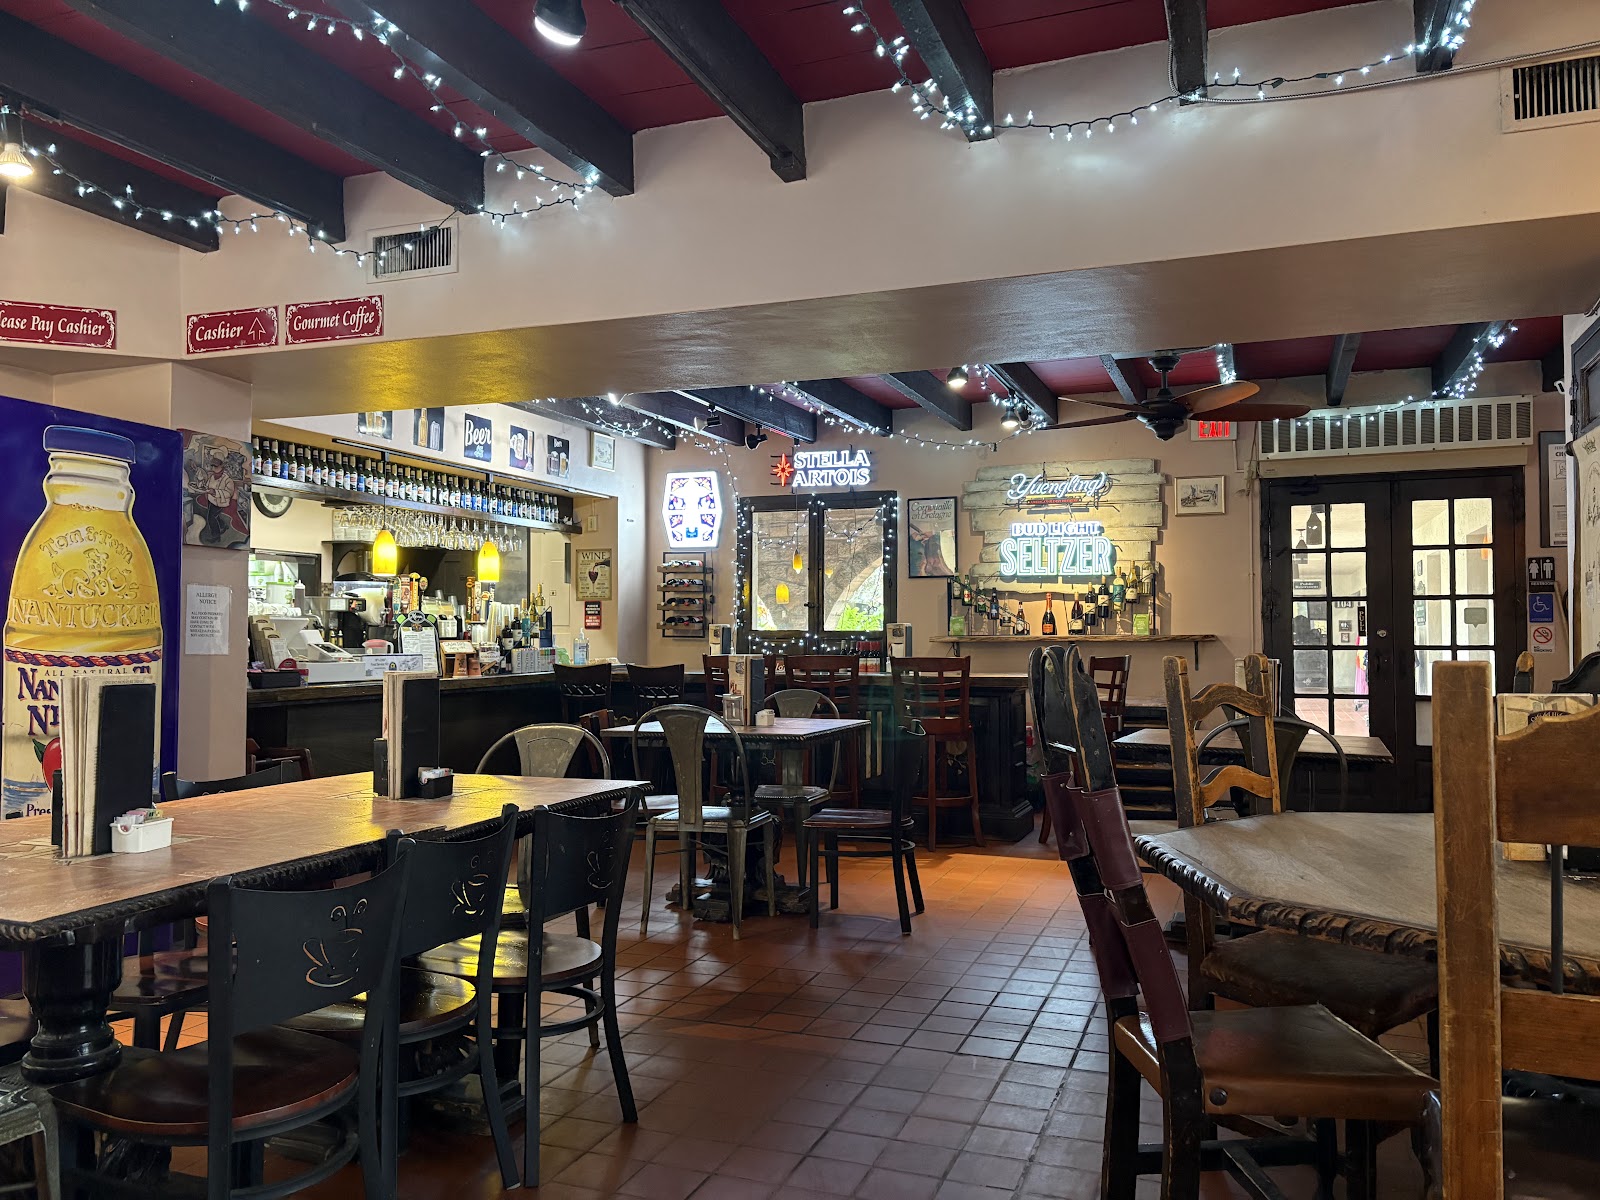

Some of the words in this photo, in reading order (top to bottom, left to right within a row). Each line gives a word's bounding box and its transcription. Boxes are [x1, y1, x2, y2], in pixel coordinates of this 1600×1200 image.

[30, 315, 54, 338] Pay
[57, 317, 105, 336] Cashier
[293, 313, 340, 331] Gourmet
[342, 306, 375, 333] Coffee
[195, 321, 244, 342] Cashier
[465, 420, 492, 446] Beer
[793, 450, 871, 468] STELLA
[792, 468, 871, 487] ARTOIS
[1007, 472, 1106, 500] Yuengling
[1011, 522, 1047, 537] BUD
[1048, 521, 1102, 536] LIGHT
[582, 552, 607, 560] WINE
[1000, 536, 1112, 577] SELTZER
[8, 597, 159, 629] NANTUCKET
[45, 669, 65, 677] ALL
